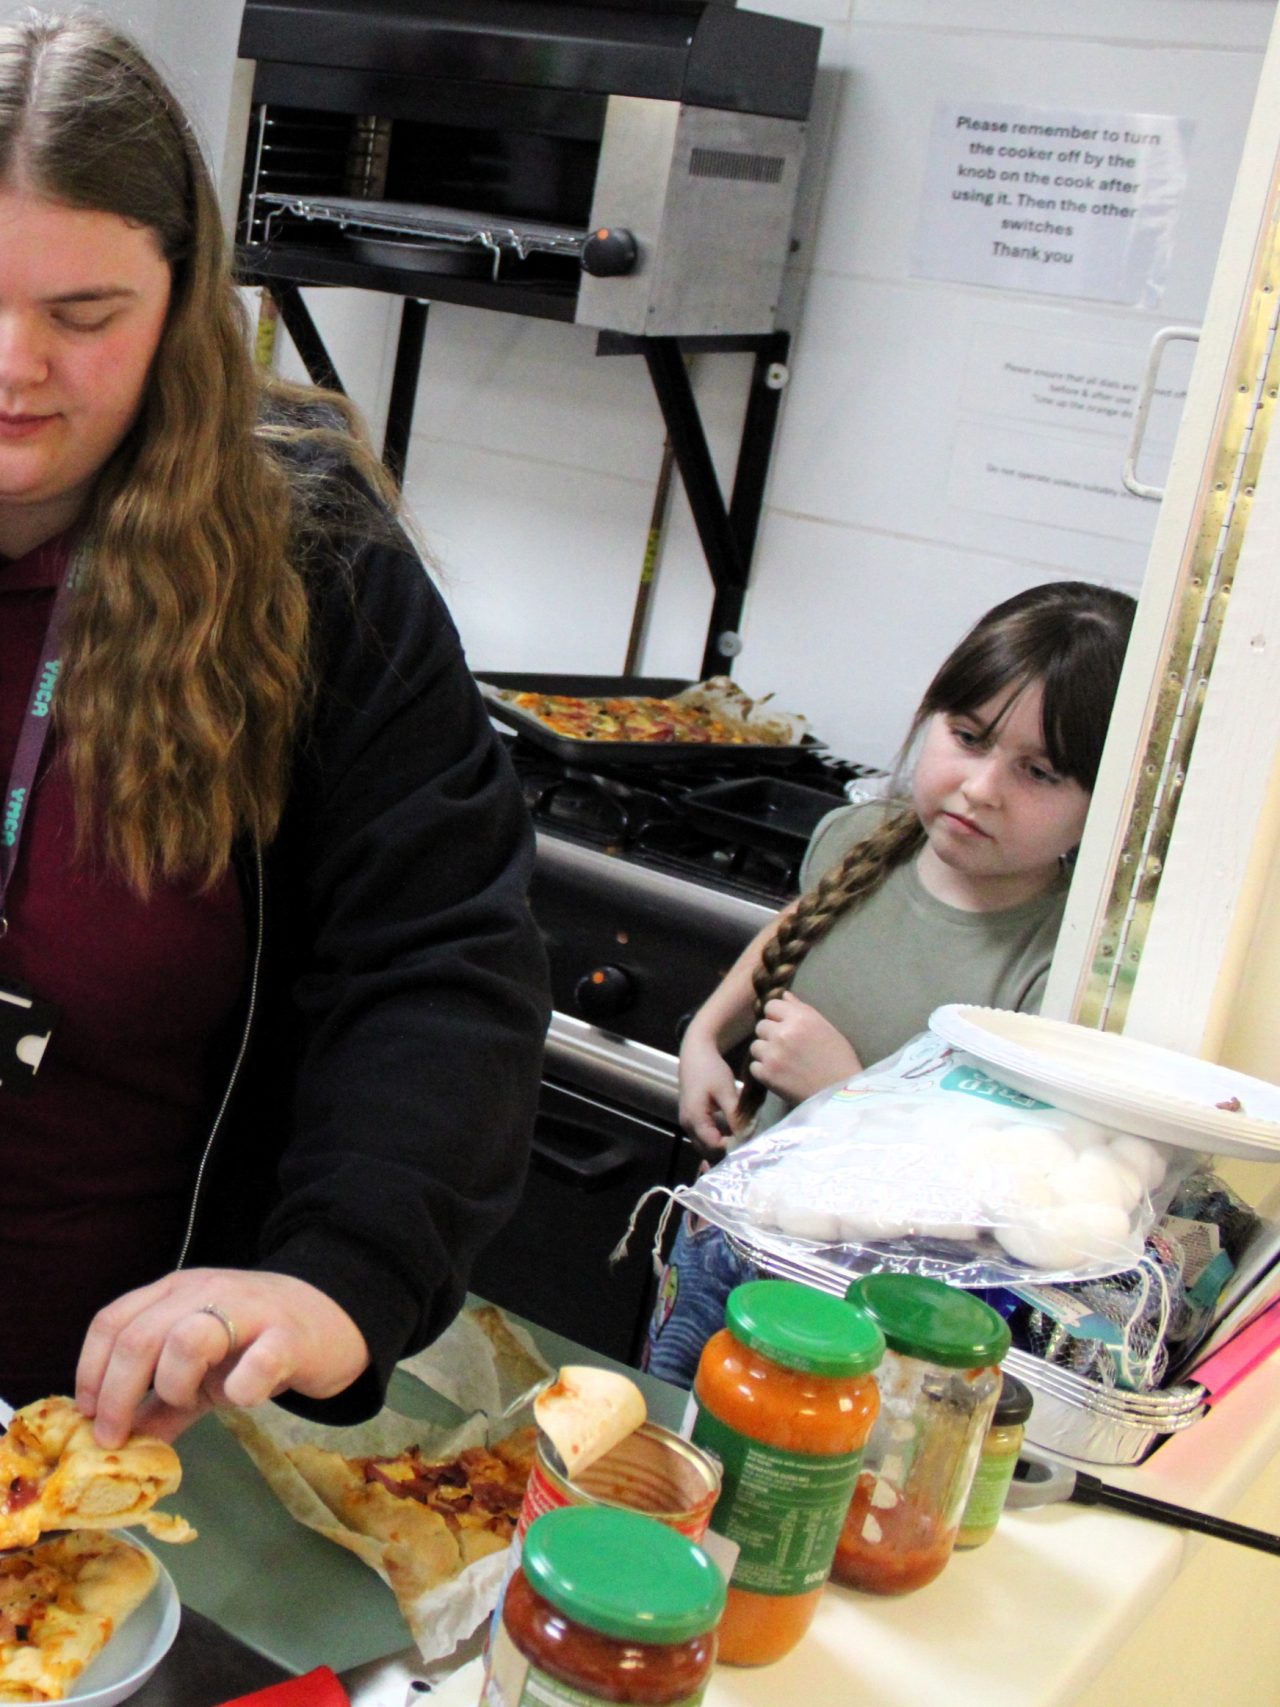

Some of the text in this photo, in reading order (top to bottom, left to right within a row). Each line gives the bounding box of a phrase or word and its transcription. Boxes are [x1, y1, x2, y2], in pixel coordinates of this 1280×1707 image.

[956, 115, 1161, 145] Please remember to turn
[969, 141, 1136, 169] the cooker off by the
[957, 164, 1140, 194] knob on the cook after
[951, 189, 1137, 218] using it. Then the other
[1001, 217, 1074, 236] switches
[992, 241, 1074, 265] Thank you
[31, 658, 62, 717] YMCA
[1, 787, 26, 847] YMCA
